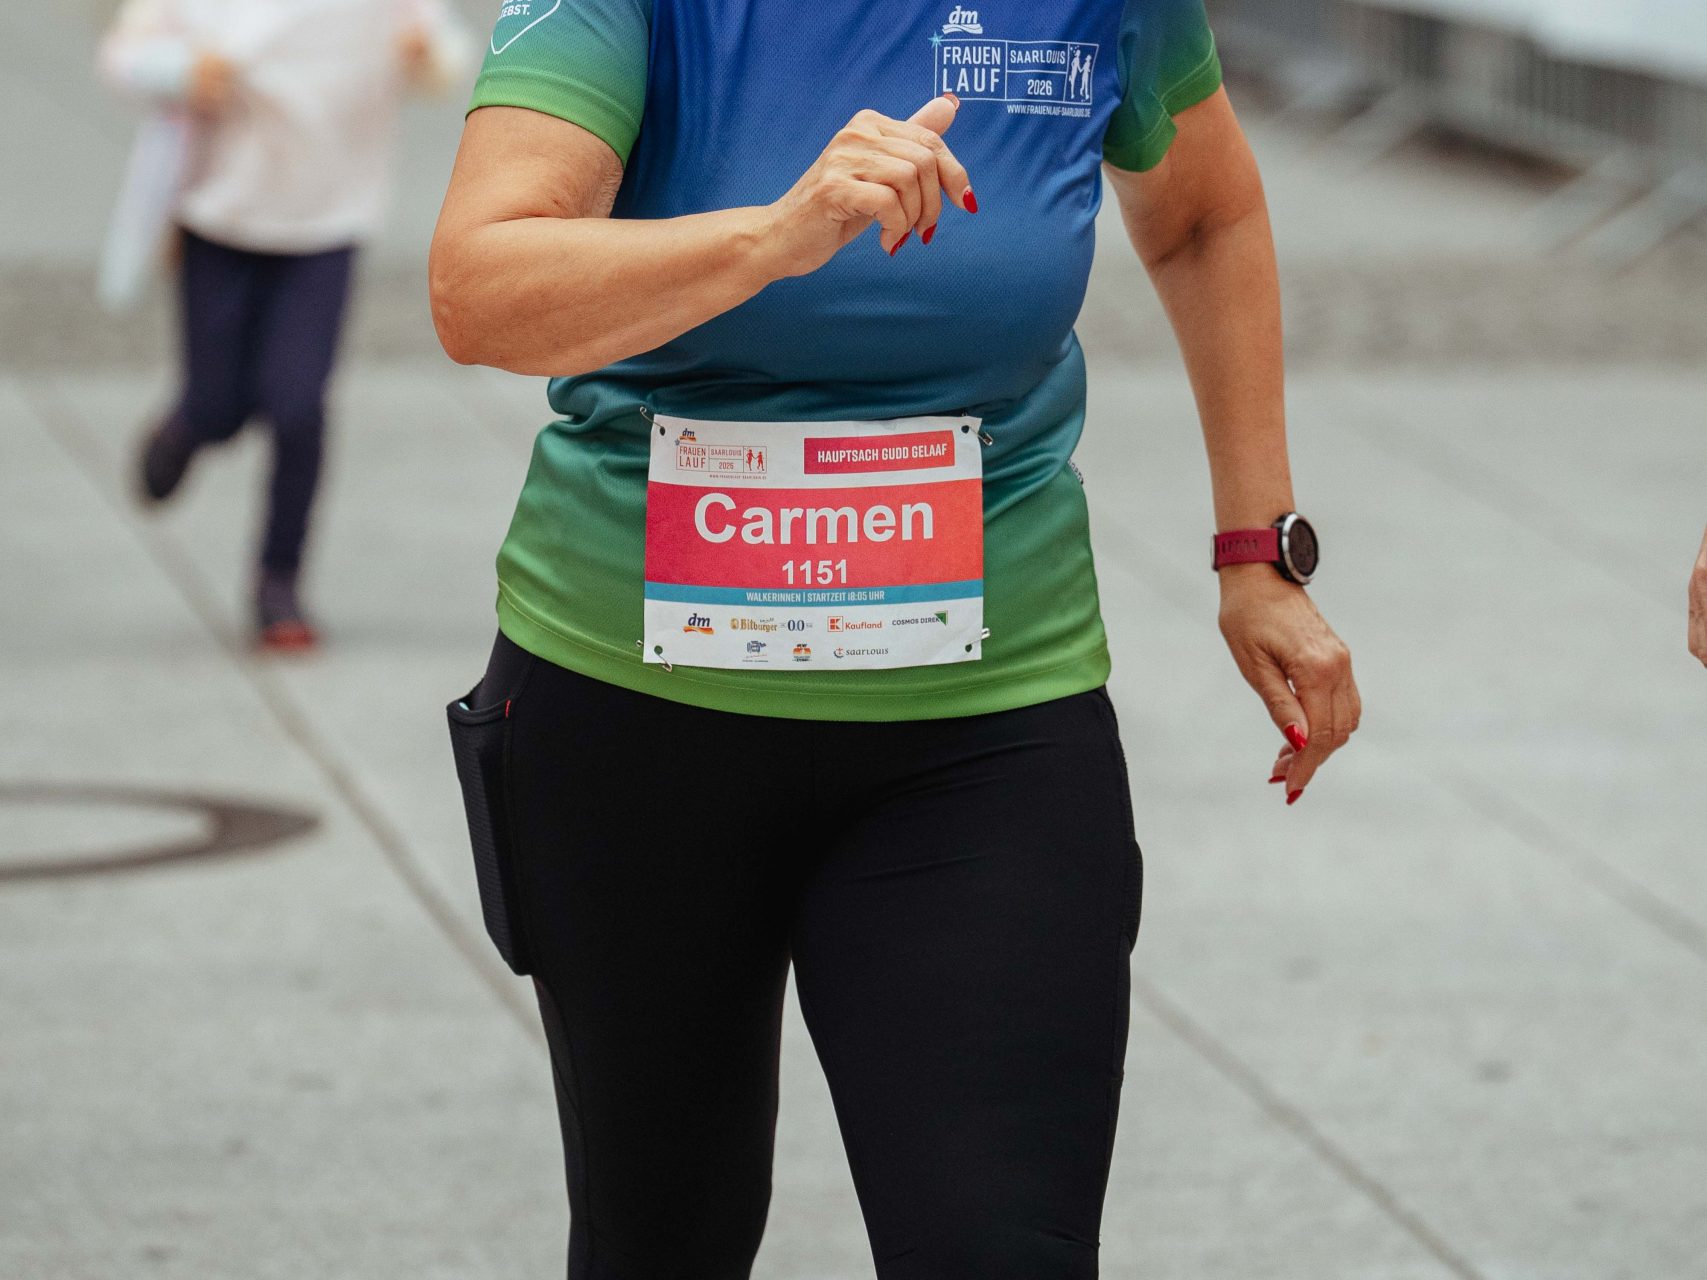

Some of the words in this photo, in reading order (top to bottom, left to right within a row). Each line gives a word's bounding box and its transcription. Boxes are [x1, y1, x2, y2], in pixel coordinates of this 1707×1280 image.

[948, 5, 979, 25] dm
[942, 46, 1001, 65] FRAUEN
[1009, 50, 1066, 65] SAARLOUIS
[942, 67, 1001, 93] LAUF
[1027, 78, 1053, 96] 2026
[679, 446, 706, 457] FRAUEN
[817, 448, 879, 463] HAUPTSACH
[881, 446, 909, 460] GUDD
[911, 443, 948, 458] GELAAF
[679, 456, 706, 469] LAUF
[718, 461, 735, 470] 2026
[694, 492, 934, 545] Carmen
[782, 558, 847, 585] 1151
[746, 591, 801, 602] WALKERINNEN
[807, 591, 846, 602] STARTZEIT
[848, 590, 868, 601] 18:05
[869, 590, 885, 600] UHR
[687, 612, 711, 628] dm
[845, 621, 883, 631] Kaufland
[892, 618, 919, 626] COSMOS
